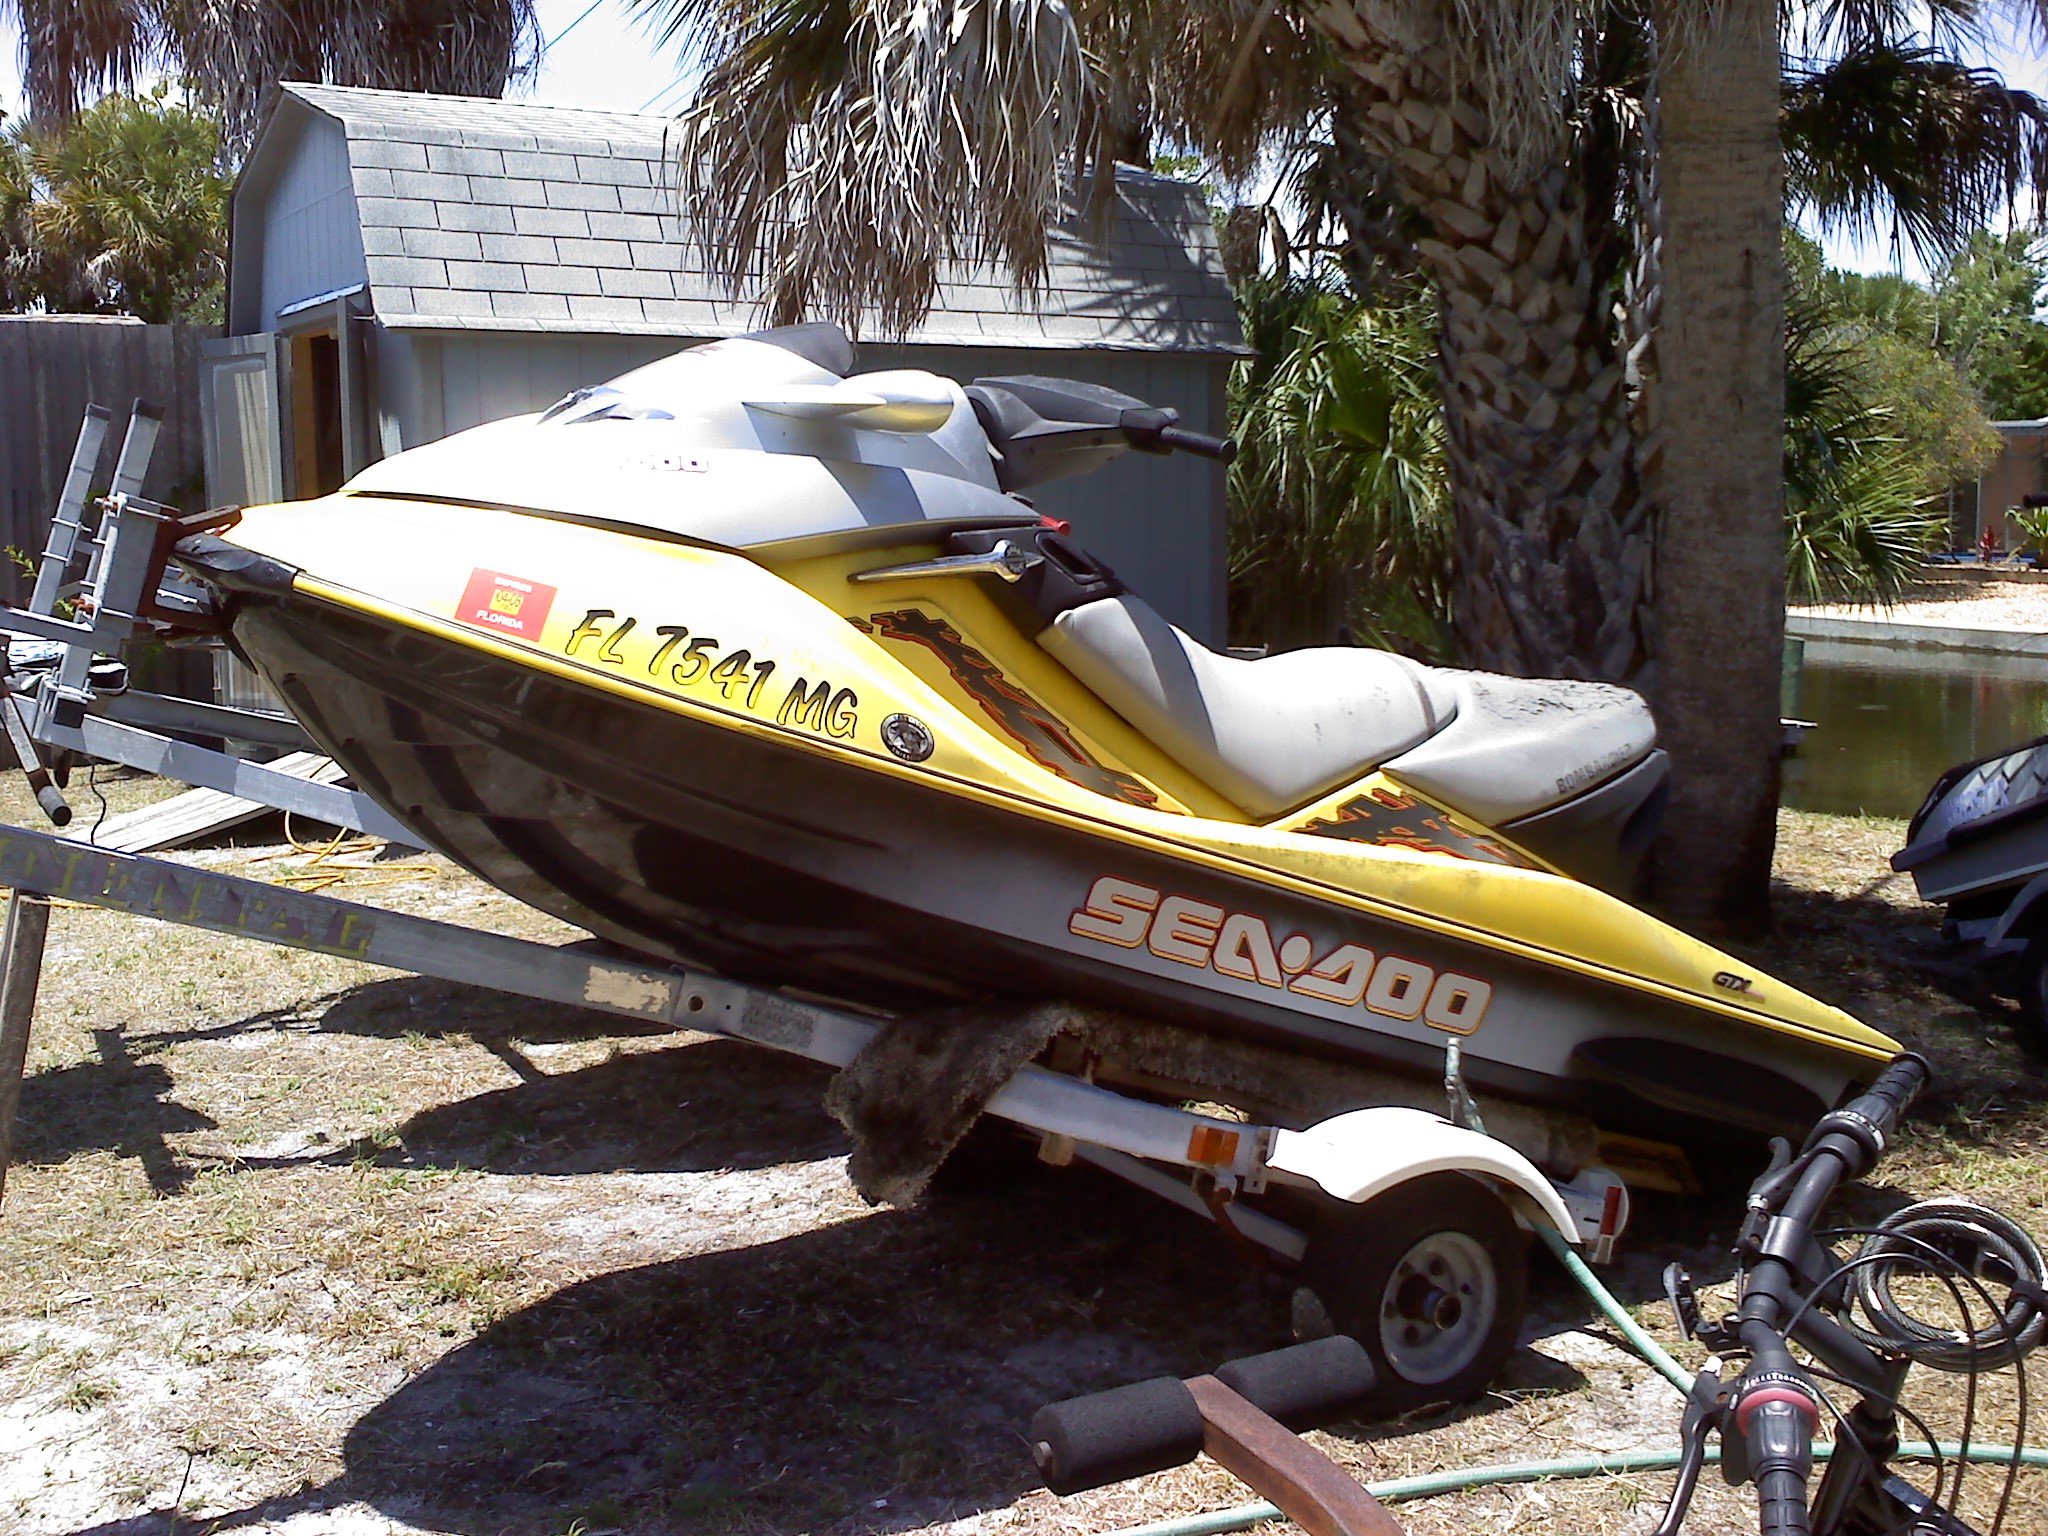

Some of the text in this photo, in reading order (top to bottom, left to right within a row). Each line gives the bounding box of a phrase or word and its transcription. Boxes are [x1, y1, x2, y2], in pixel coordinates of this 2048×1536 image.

[475, 609, 524, 630] FLORIDA
[565, 609, 637, 665] FL
[648, 625, 776, 709] 7541
[776, 678, 858, 739] MG
